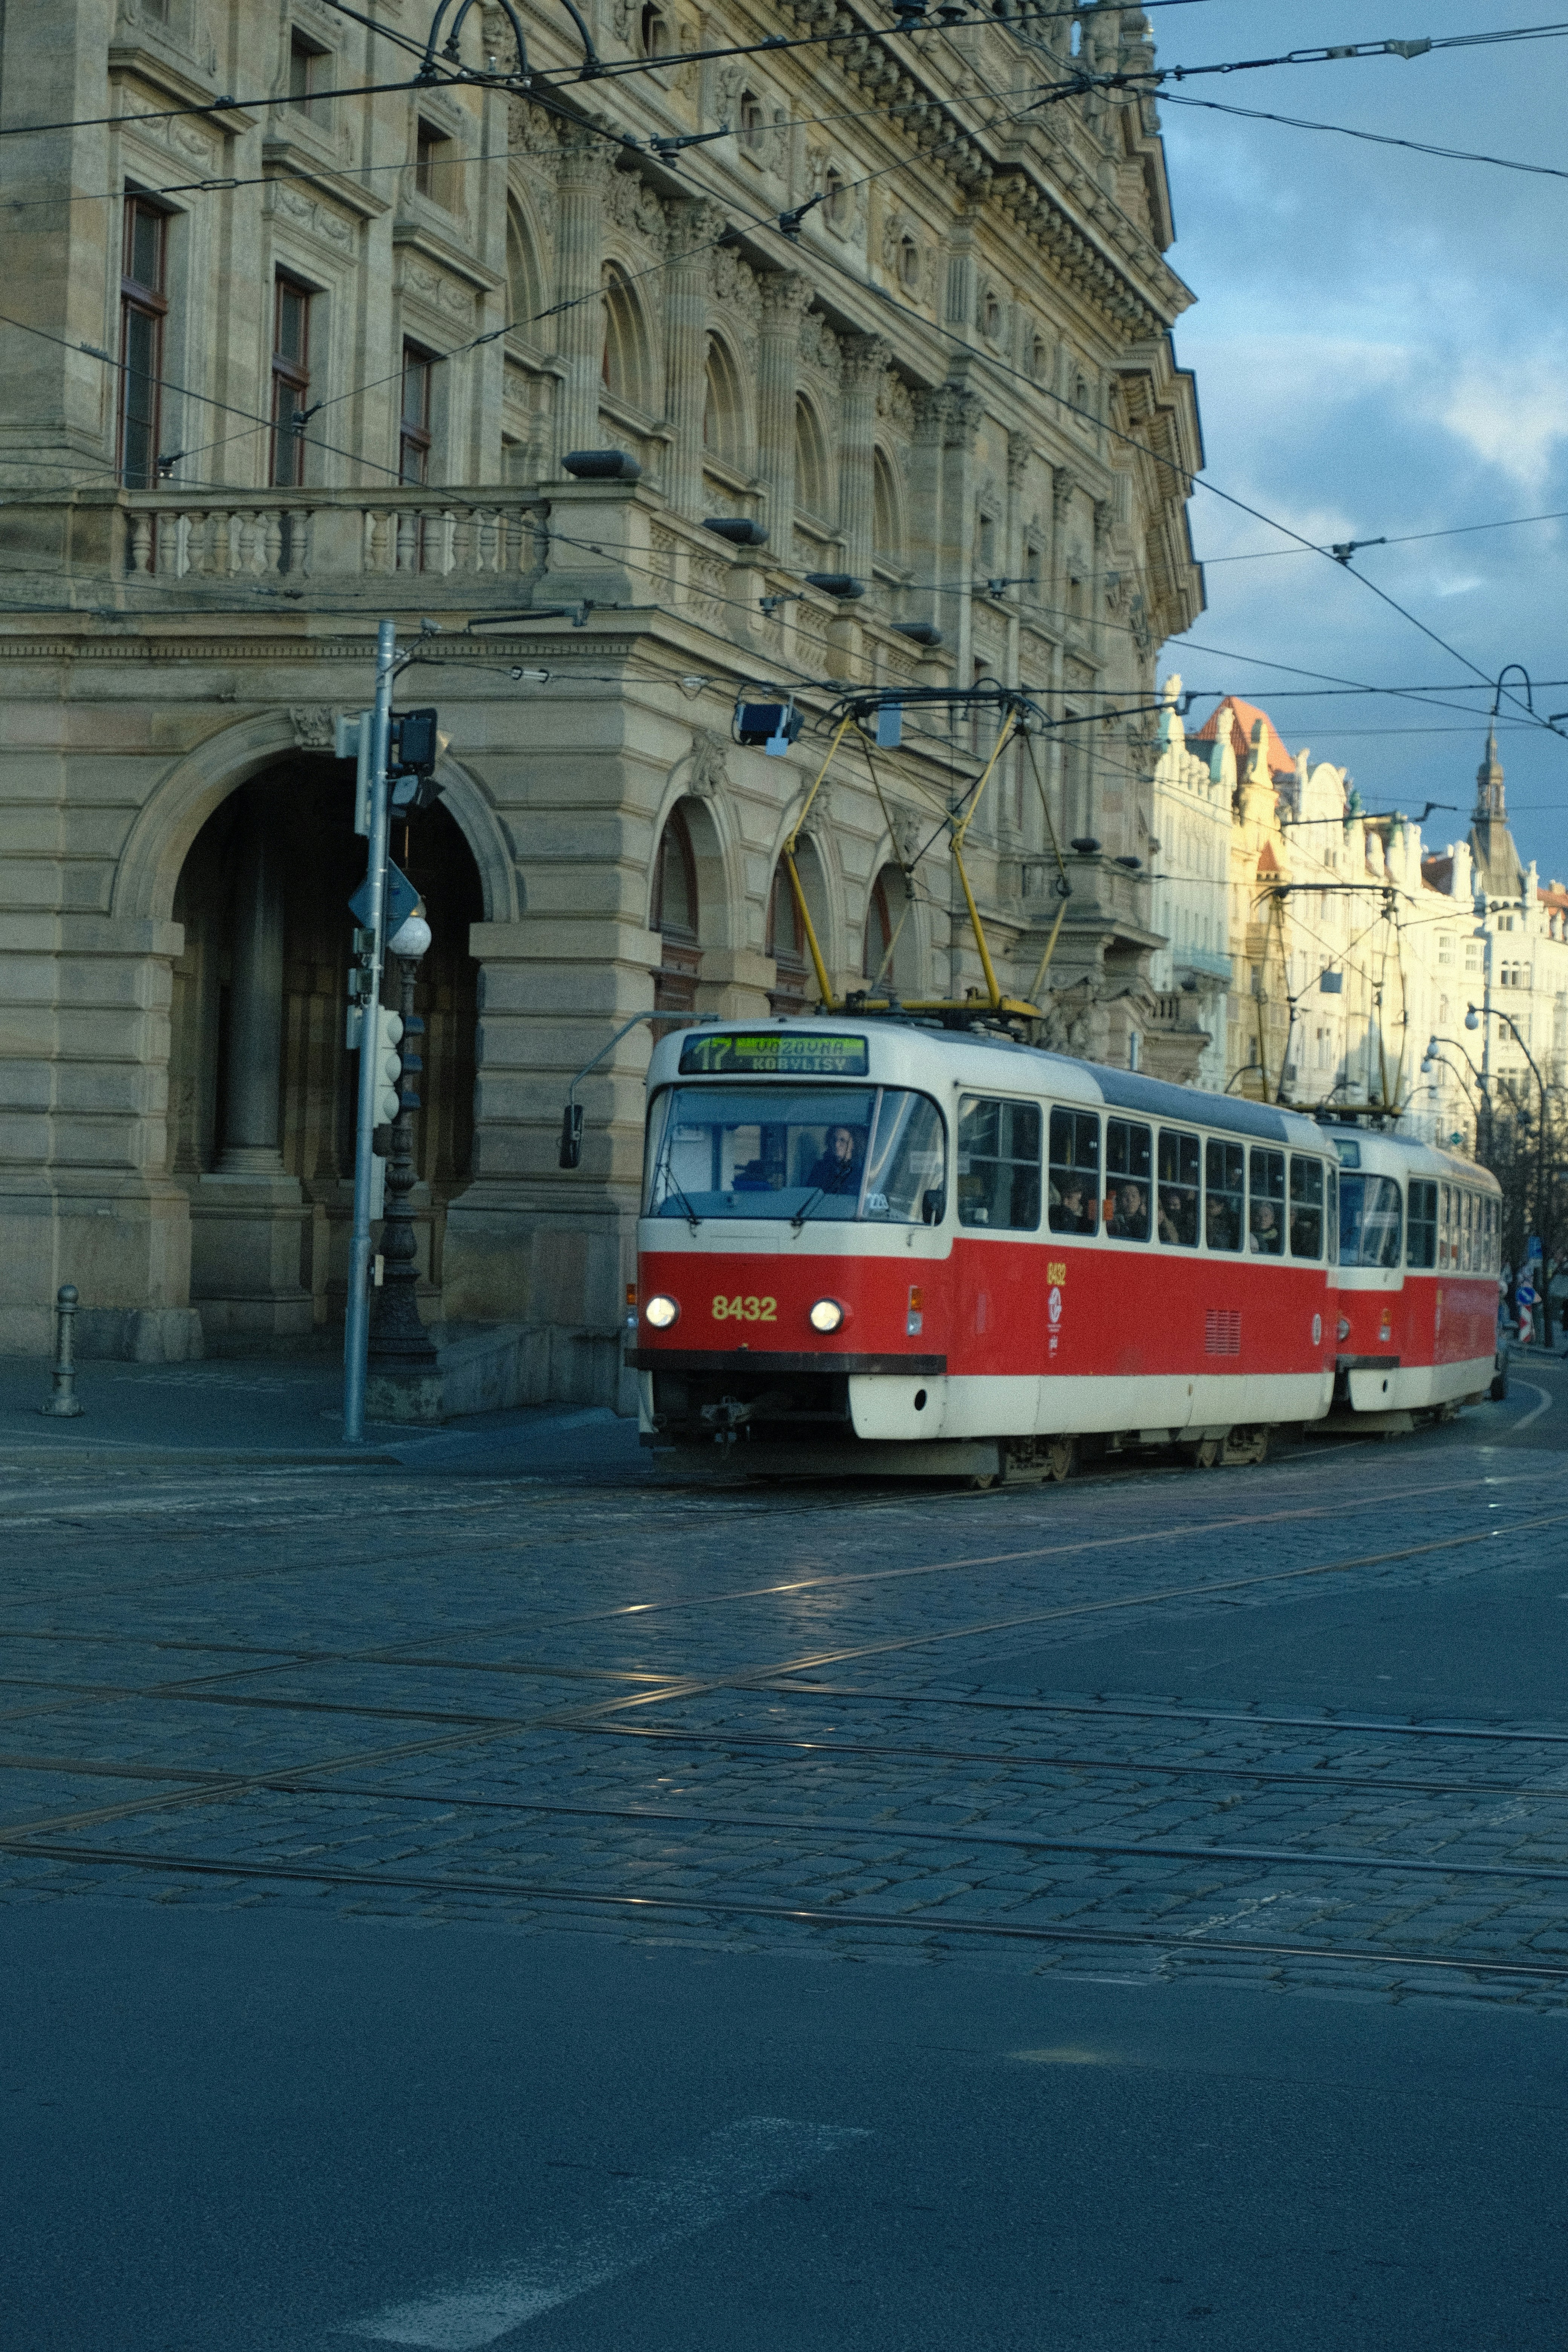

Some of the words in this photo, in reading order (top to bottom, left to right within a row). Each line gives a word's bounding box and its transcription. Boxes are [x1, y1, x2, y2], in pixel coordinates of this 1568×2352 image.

[694, 1037, 732, 1070] 17
[756, 1040, 845, 1055] VOZOVNA
[752, 1057, 846, 1071] KOBYLISY
[712, 1295, 777, 1321] 8432
